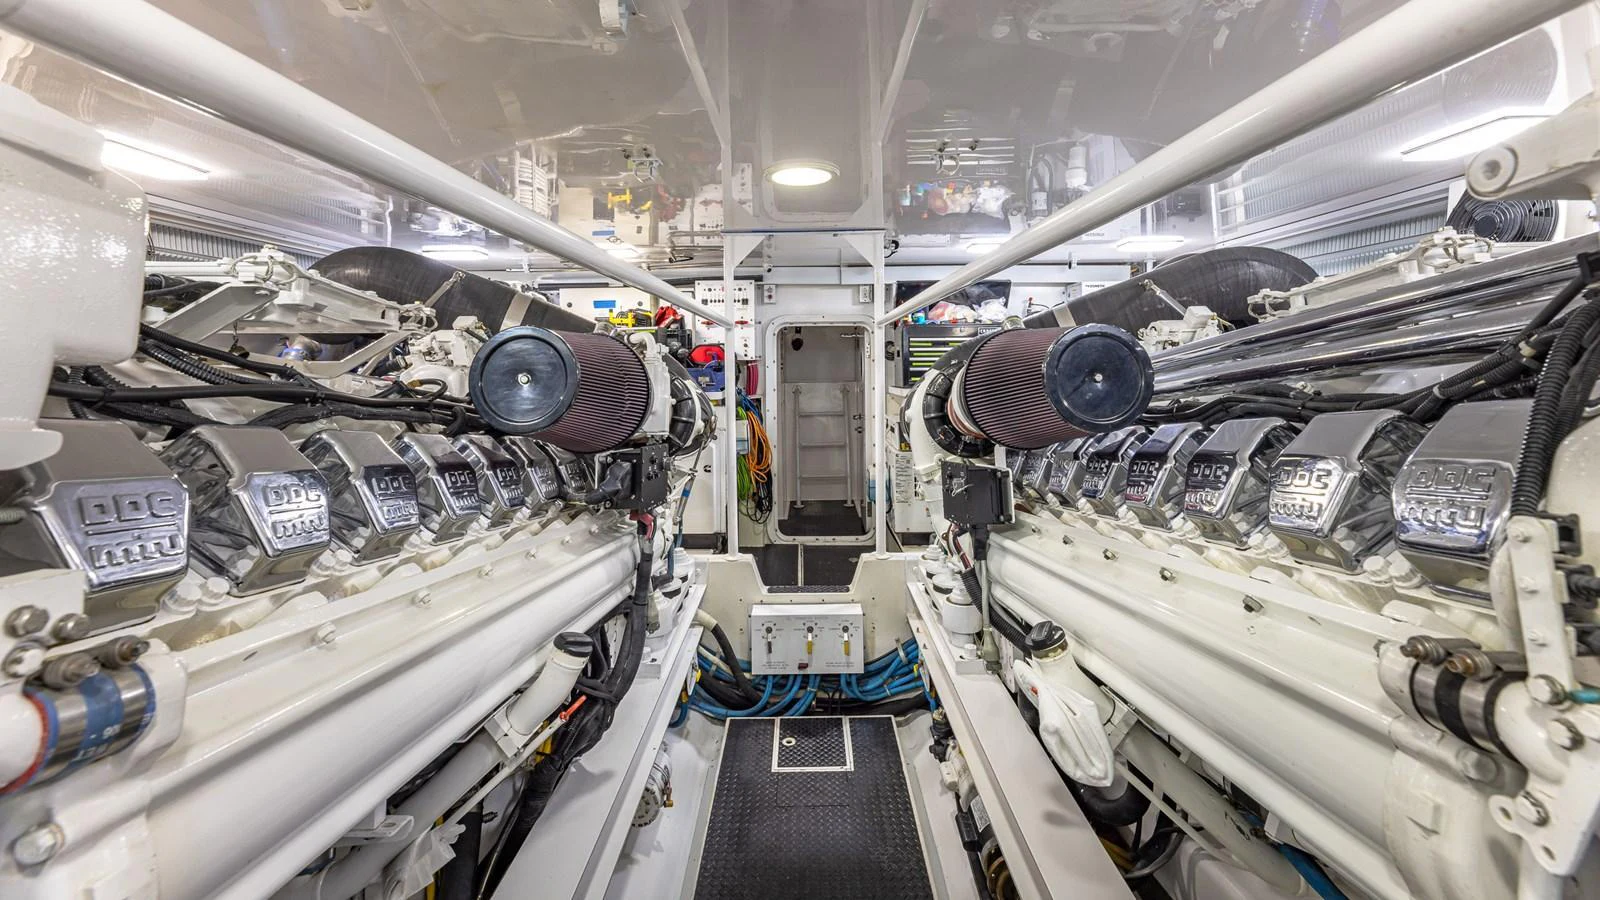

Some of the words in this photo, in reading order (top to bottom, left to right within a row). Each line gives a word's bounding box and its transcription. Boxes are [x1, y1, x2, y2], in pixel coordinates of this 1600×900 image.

[1278, 466, 1330, 490] DDC
[1406, 464, 1496, 493] DDC
[77, 491, 177, 526] DDC
[265, 482, 322, 509] DDC
